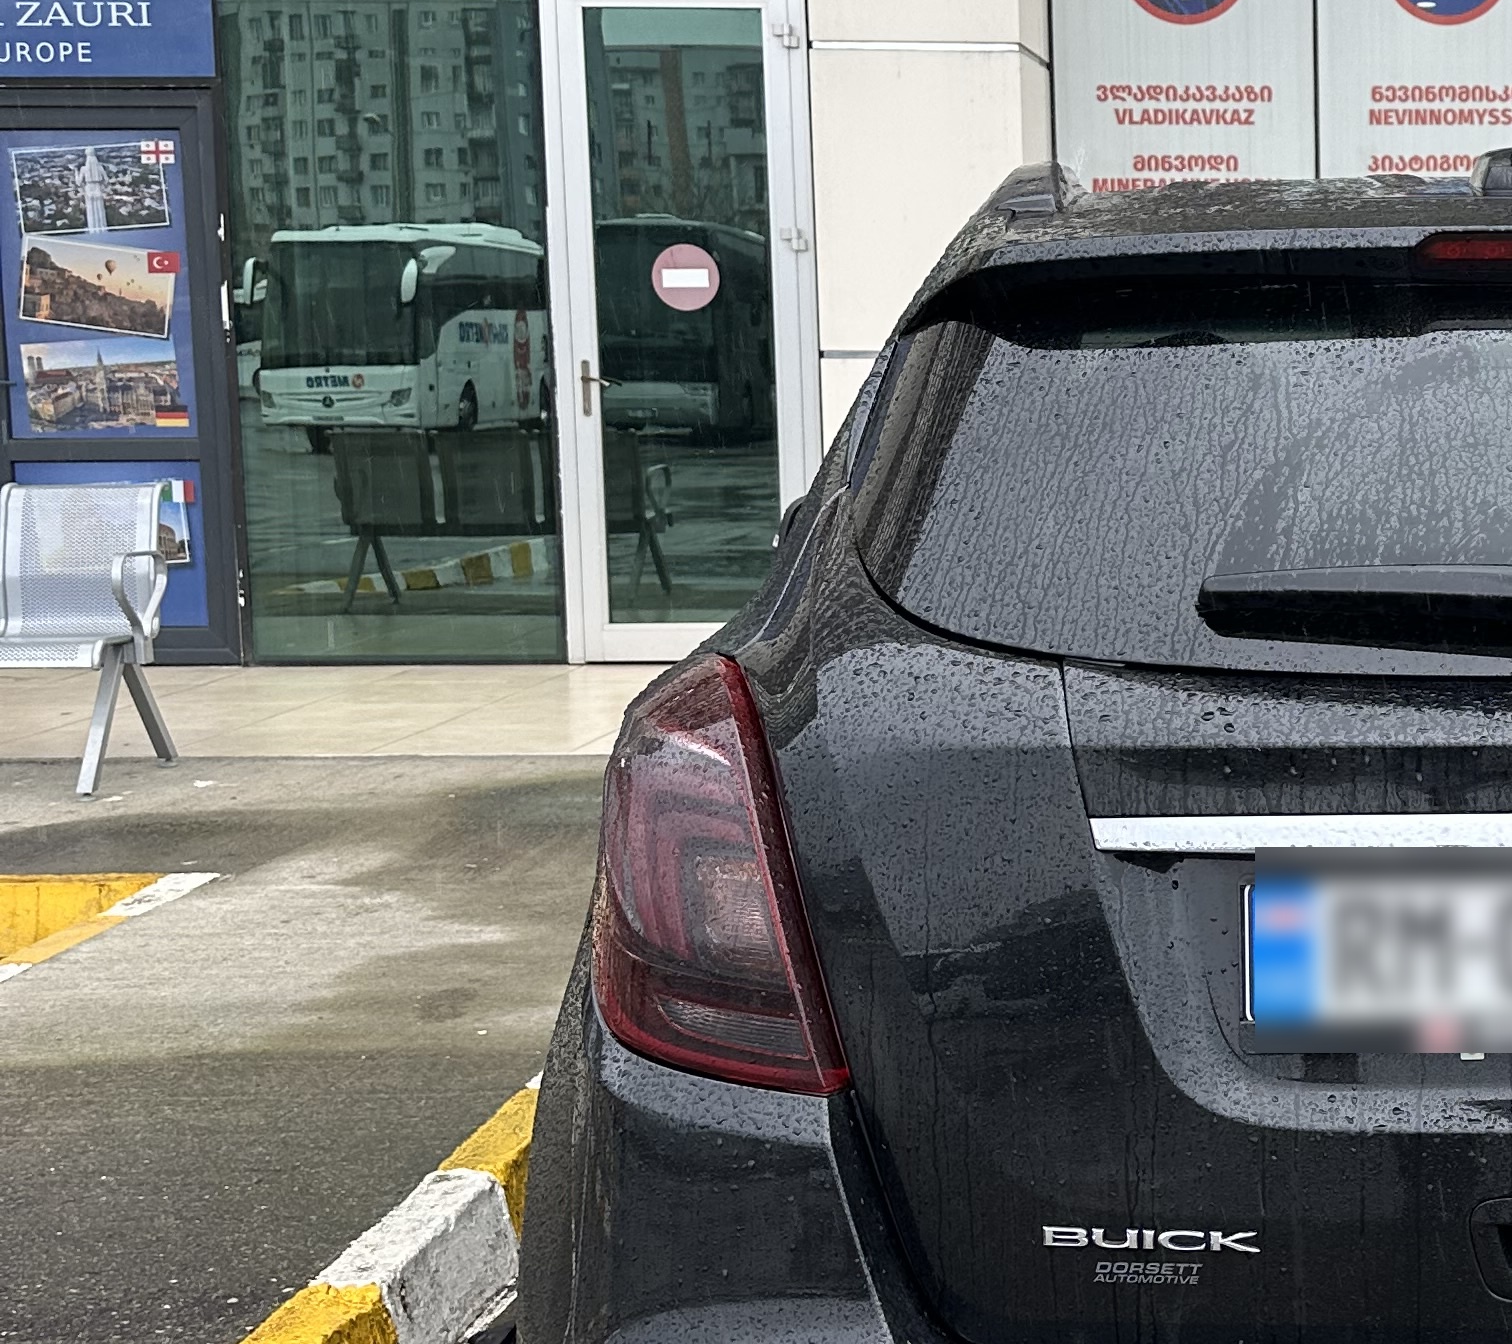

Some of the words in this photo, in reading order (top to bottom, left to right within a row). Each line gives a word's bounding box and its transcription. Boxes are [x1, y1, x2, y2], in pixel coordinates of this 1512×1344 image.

[16, 1, 152, 27] ZAURI
[1096, 84, 1273, 102] ვლადიკავკაზი
[1114, 109, 1255, 125] VLADIKAVKAZ
[1133, 154, 1239, 172] მინვოდი
[1042, 1225, 1261, 1253] BUICK
[1095, 1261, 1203, 1275] DORSETT
[1093, 1274, 1199, 1285] AUTOMOTIVE
